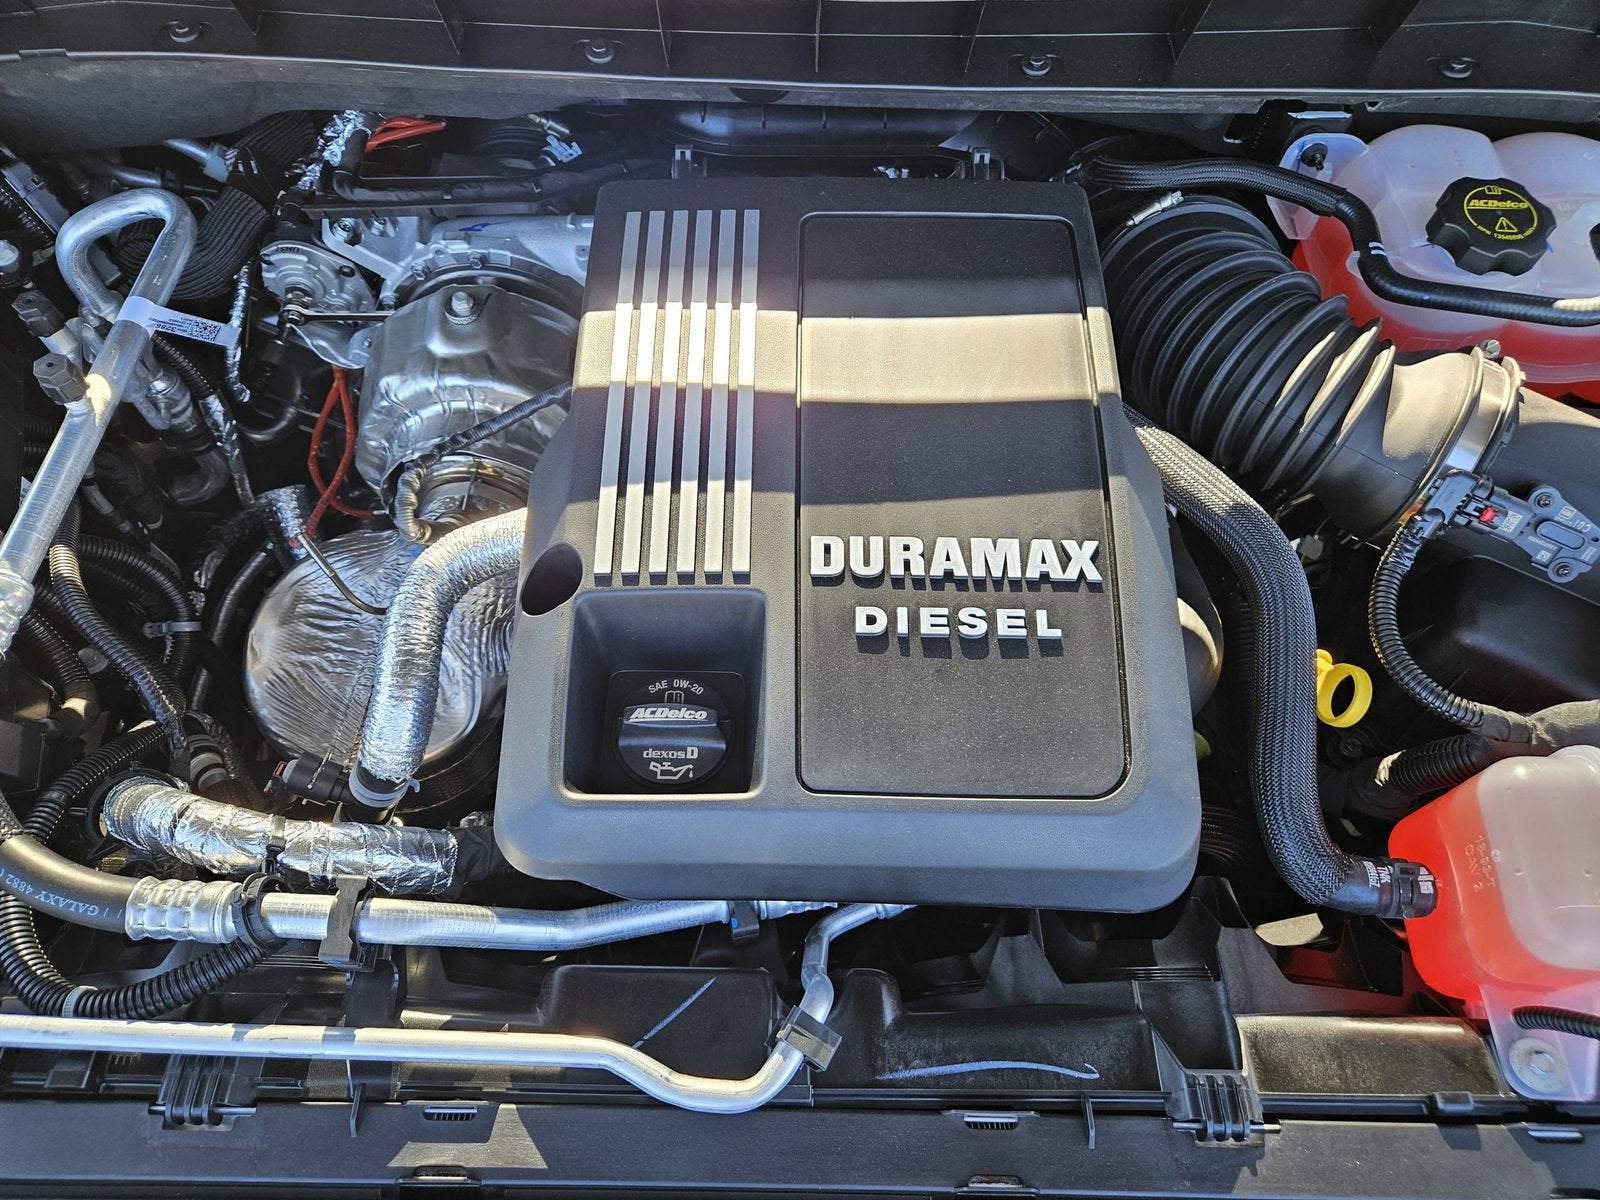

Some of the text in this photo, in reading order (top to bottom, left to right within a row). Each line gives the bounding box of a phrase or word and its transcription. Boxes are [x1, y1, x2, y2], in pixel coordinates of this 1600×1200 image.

[1468, 199, 1529, 209] ACDelco
[810, 535, 1103, 582] DURAMAX
[855, 606, 1062, 639] DIESEL
[648, 680, 668, 694] SAE
[629, 707, 708, 720] ACDelco
[5, 874, 99, 916] GALAXY 4882
